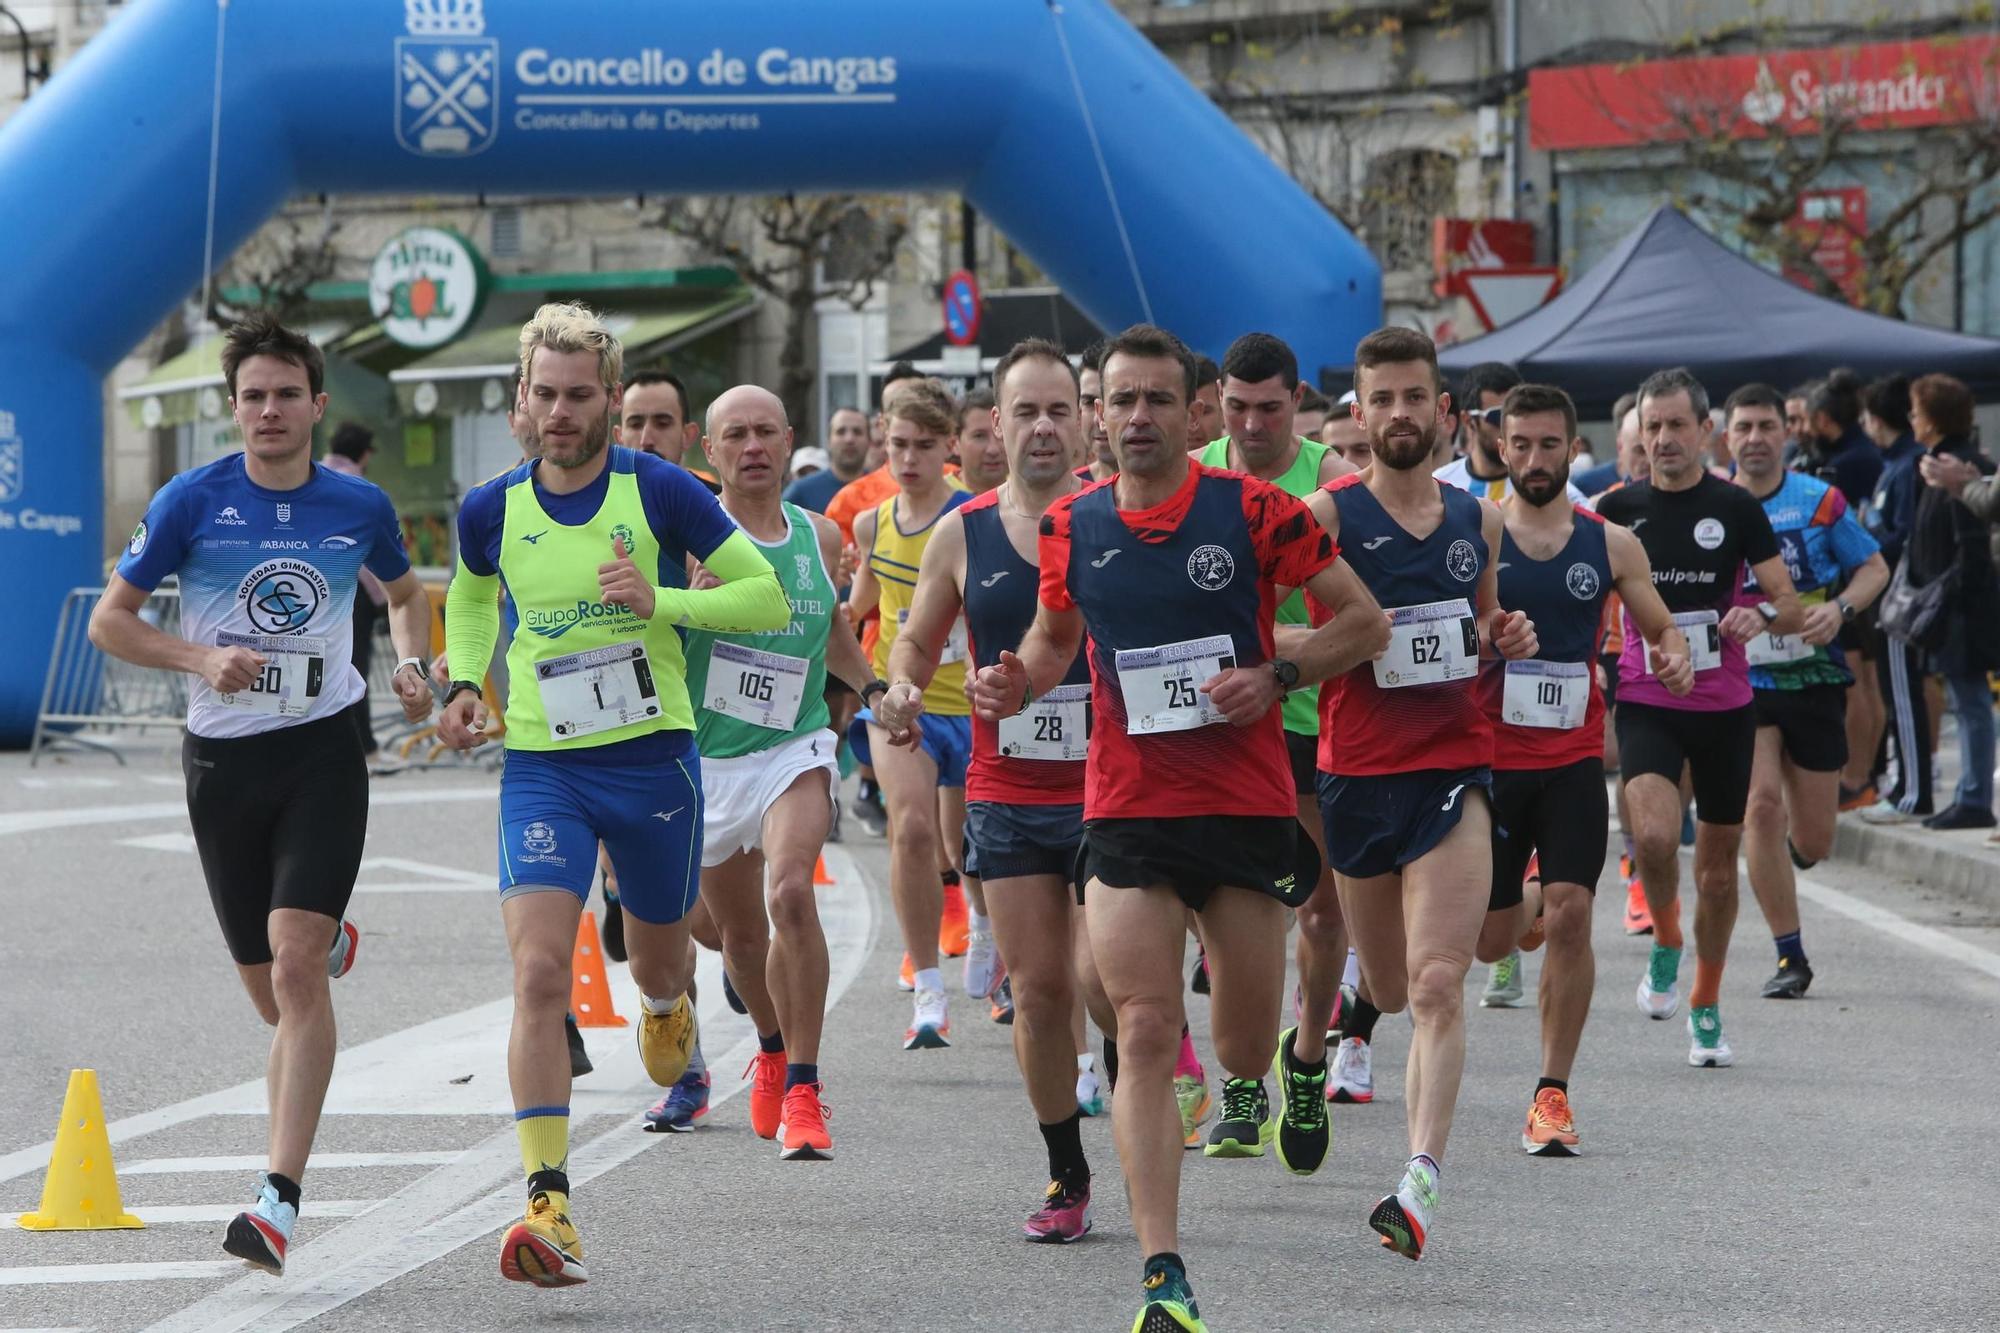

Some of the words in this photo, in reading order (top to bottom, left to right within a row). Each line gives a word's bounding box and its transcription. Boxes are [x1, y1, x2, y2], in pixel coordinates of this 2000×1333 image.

[516, 48, 688, 86] Concello
[698, 48, 746, 85] de
[756, 48, 898, 94] Cangas
[636, 108, 658, 131] de
[664, 109, 760, 134] Deportes
[238, 563, 277, 600] SOCIEDAD
[581, 617, 613, 629] servicios
[610, 627, 616, 635] y
[617, 623, 647, 634] urbanos
[1167, 657, 1193, 665] MEMORIAL
[1411, 635, 1442, 665] 62
[593, 682, 604, 710] 1
[738, 671, 775, 702] 105
[1163, 677, 1198, 709] 25
[1537, 682, 1563, 706] 101
[1034, 716, 1063, 742] 28
